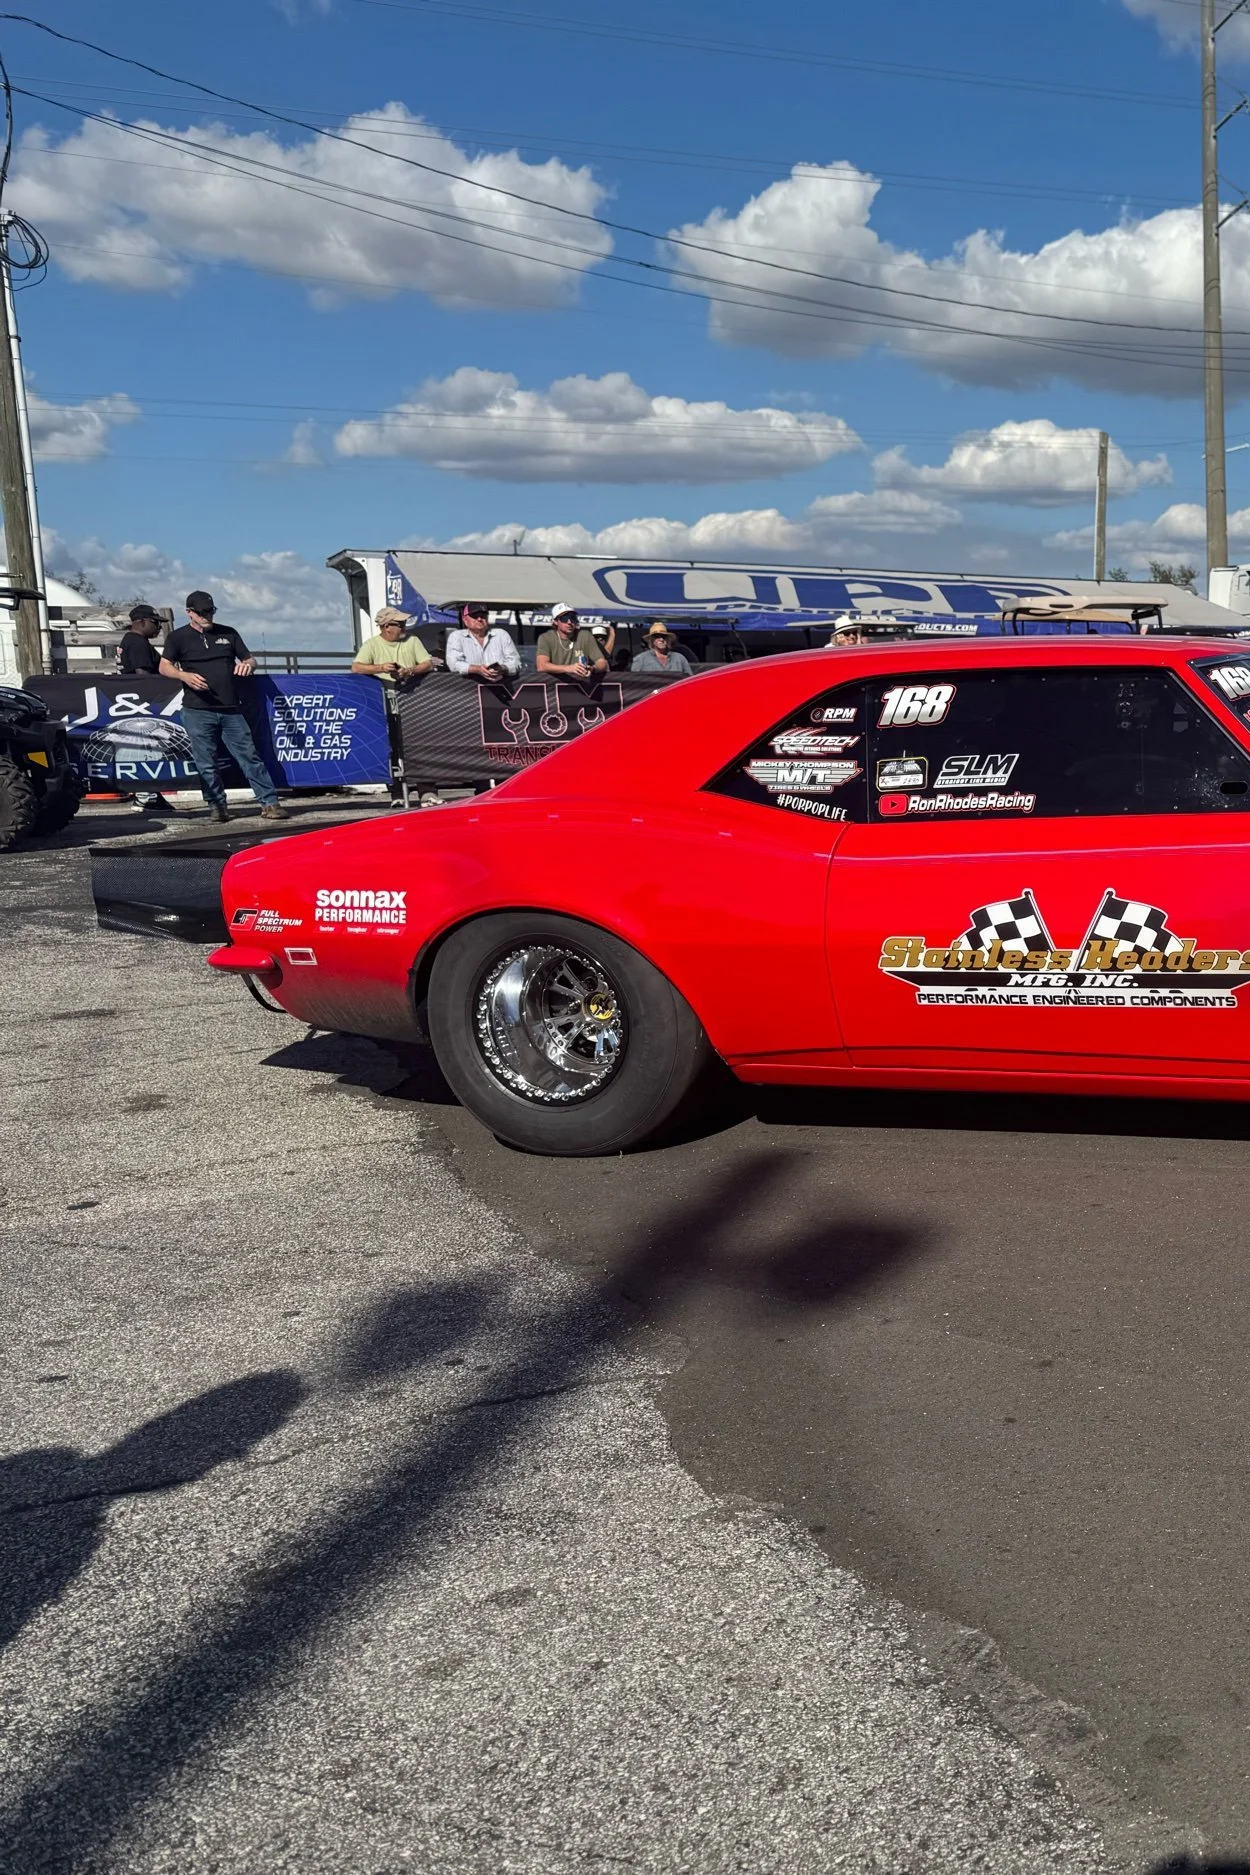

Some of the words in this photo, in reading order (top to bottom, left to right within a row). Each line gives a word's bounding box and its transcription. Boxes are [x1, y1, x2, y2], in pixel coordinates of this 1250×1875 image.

[914, 623, 978, 632] DUCTS.COM
[273, 694, 334, 708] EXPERT
[878, 684, 956, 728] 168
[273, 708, 357, 721] SOLUTIONS
[823, 707, 858, 719] RPM
[275, 722, 307, 735] FOR
[313, 721, 344, 734] THE
[276, 736, 298, 748] OIL
[304, 735, 316, 748] &
[320, 735, 352, 747] GAS
[771, 735, 860, 747] SPEEDTECH
[277, 748, 352, 762] INDUSTRY
[73, 760, 199, 780] ERVIC
[940, 754, 1018, 778] SLM
[776, 769, 831, 785] M/T
[908, 791, 1036, 813] RonRhodesRacing
[316, 889, 407, 908] sonnax
[260, 909, 280, 918] FULL
[315, 908, 407, 924] PERFORMANCE
[256, 917, 303, 926] SPECTRUM
[254, 925, 283, 933] POWER
[879, 937, 1072, 972] Stainless
[1006, 973, 1074, 988] MFG.
[1080, 974, 1140, 988] INC.
[916, 992, 1027, 1005] PERFORMANCE
[1032, 994, 1126, 1006] ENGINEERED
[1130, 995, 1237, 1007] COMPONENTS
